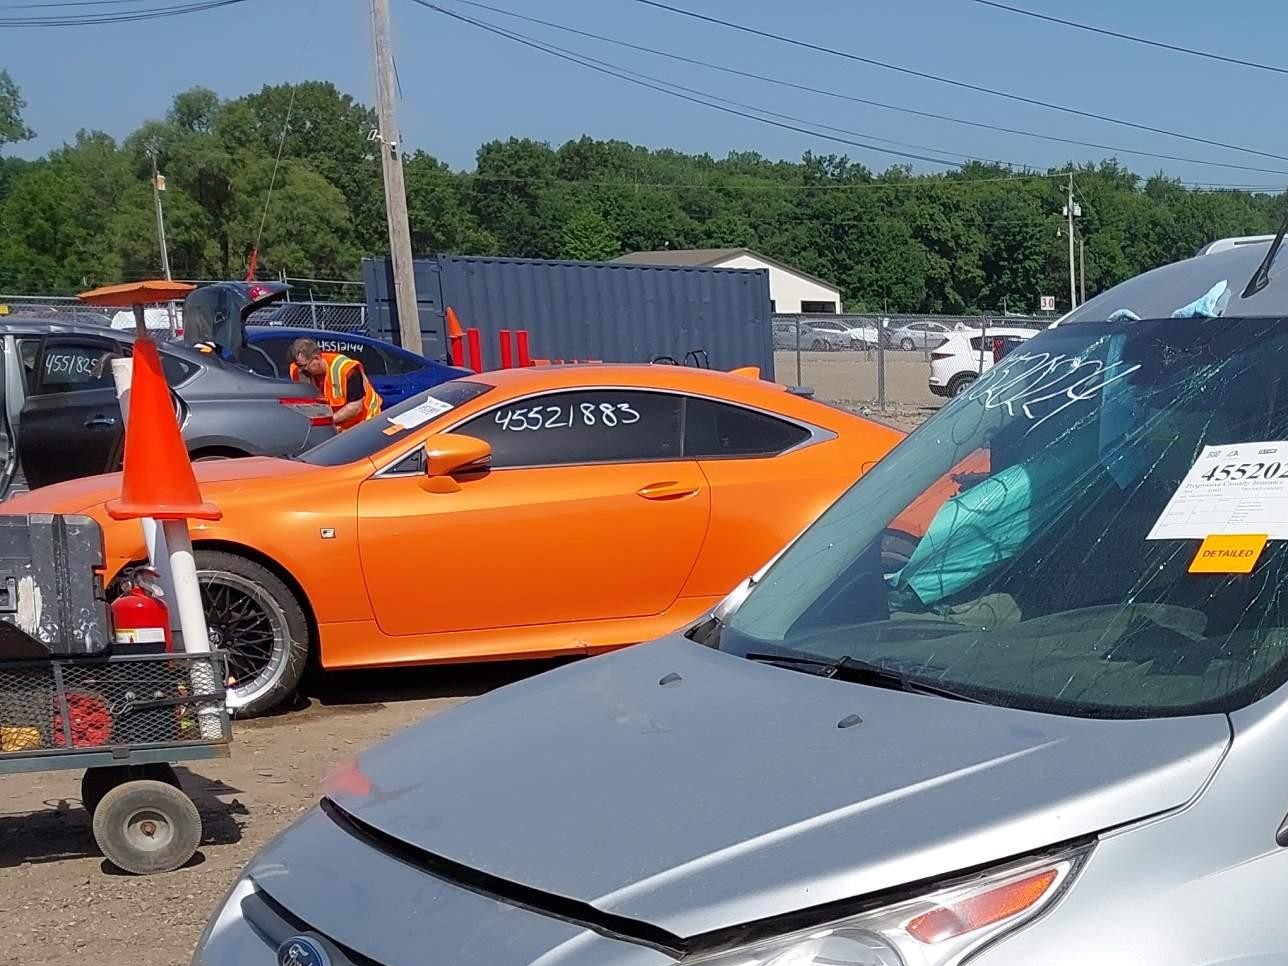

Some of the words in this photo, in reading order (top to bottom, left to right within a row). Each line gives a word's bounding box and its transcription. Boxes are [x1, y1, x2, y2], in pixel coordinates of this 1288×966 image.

[1041, 297, 1054, 308] 30
[494, 402, 641, 431] 45521883
[1202, 549, 1254, 558] DETAILED
